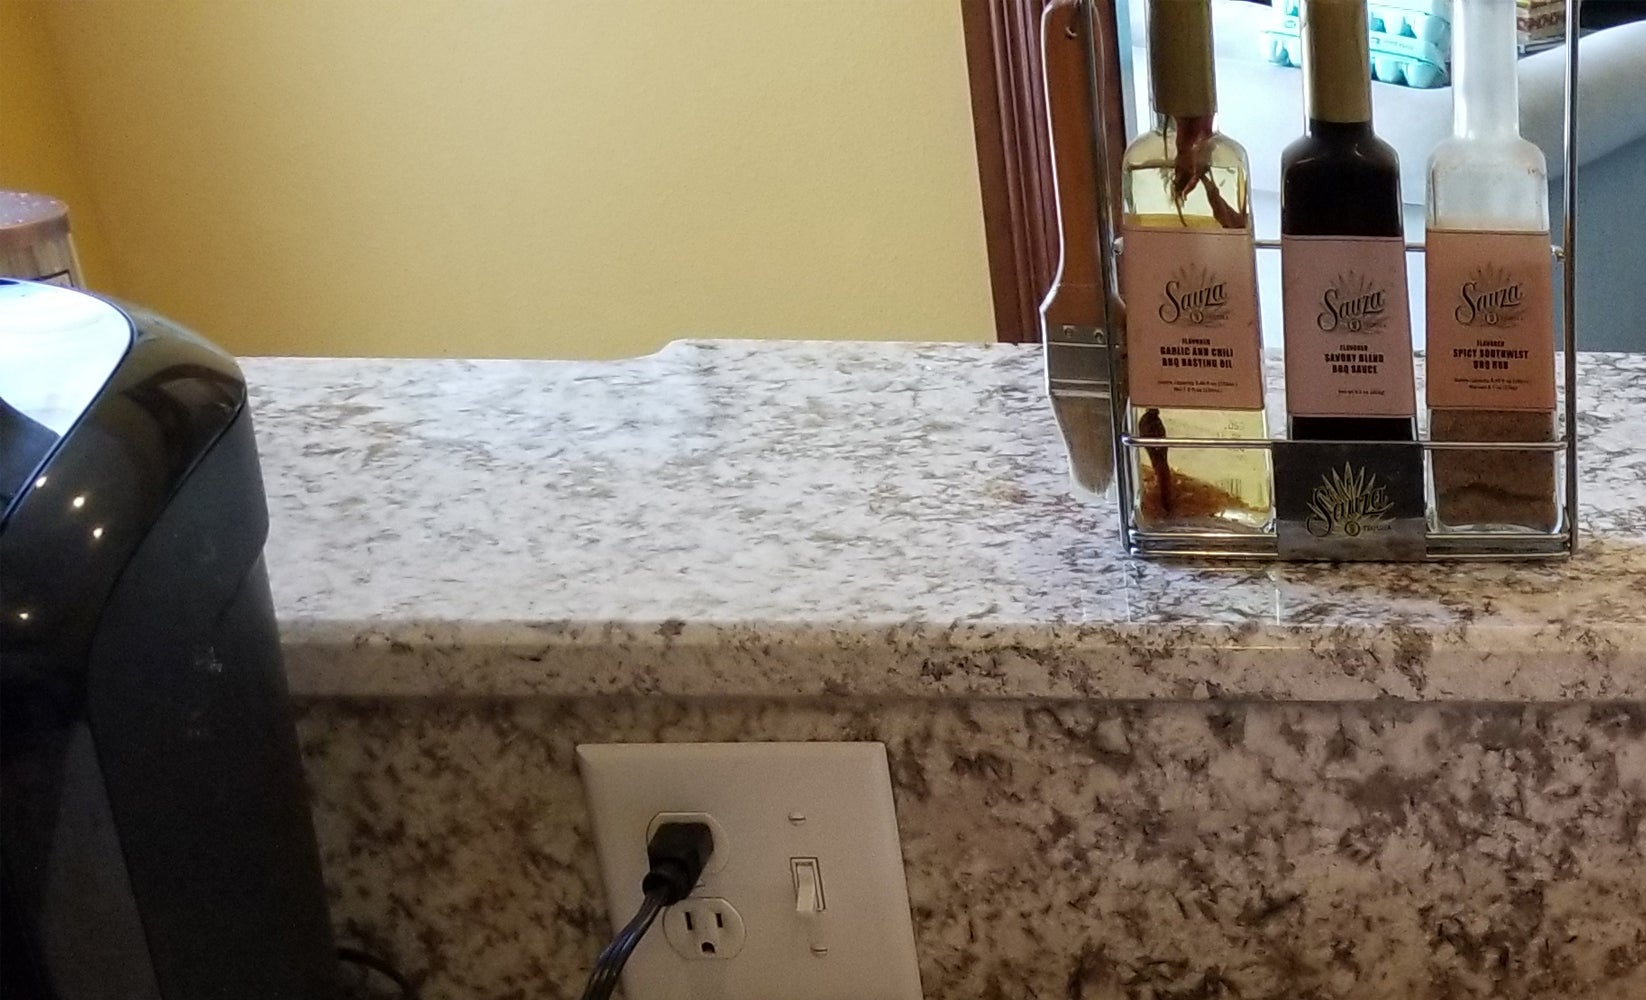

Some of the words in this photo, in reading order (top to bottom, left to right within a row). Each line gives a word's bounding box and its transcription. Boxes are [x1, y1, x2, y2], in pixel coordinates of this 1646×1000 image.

[1159, 281, 1227, 324] Sauza
[1455, 282, 1524, 326] Sauza
[1317, 288, 1386, 332] Sauza
[1160, 346, 1191, 355] GARLIC
[1192, 347, 1209, 356] AND
[1211, 348, 1234, 357] CHILI
[1453, 349, 1477, 358] SPICY
[1479, 349, 1529, 359] SOUTHWEST
[1181, 358, 1218, 368] BASTING
[1220, 359, 1233, 368] OIL
[1324, 353, 1357, 363] SAVORY
[1358, 354, 1385, 363] BLEND
[1332, 364, 1349, 374] BBQ
[1351, 365, 1378, 374] SAUCE
